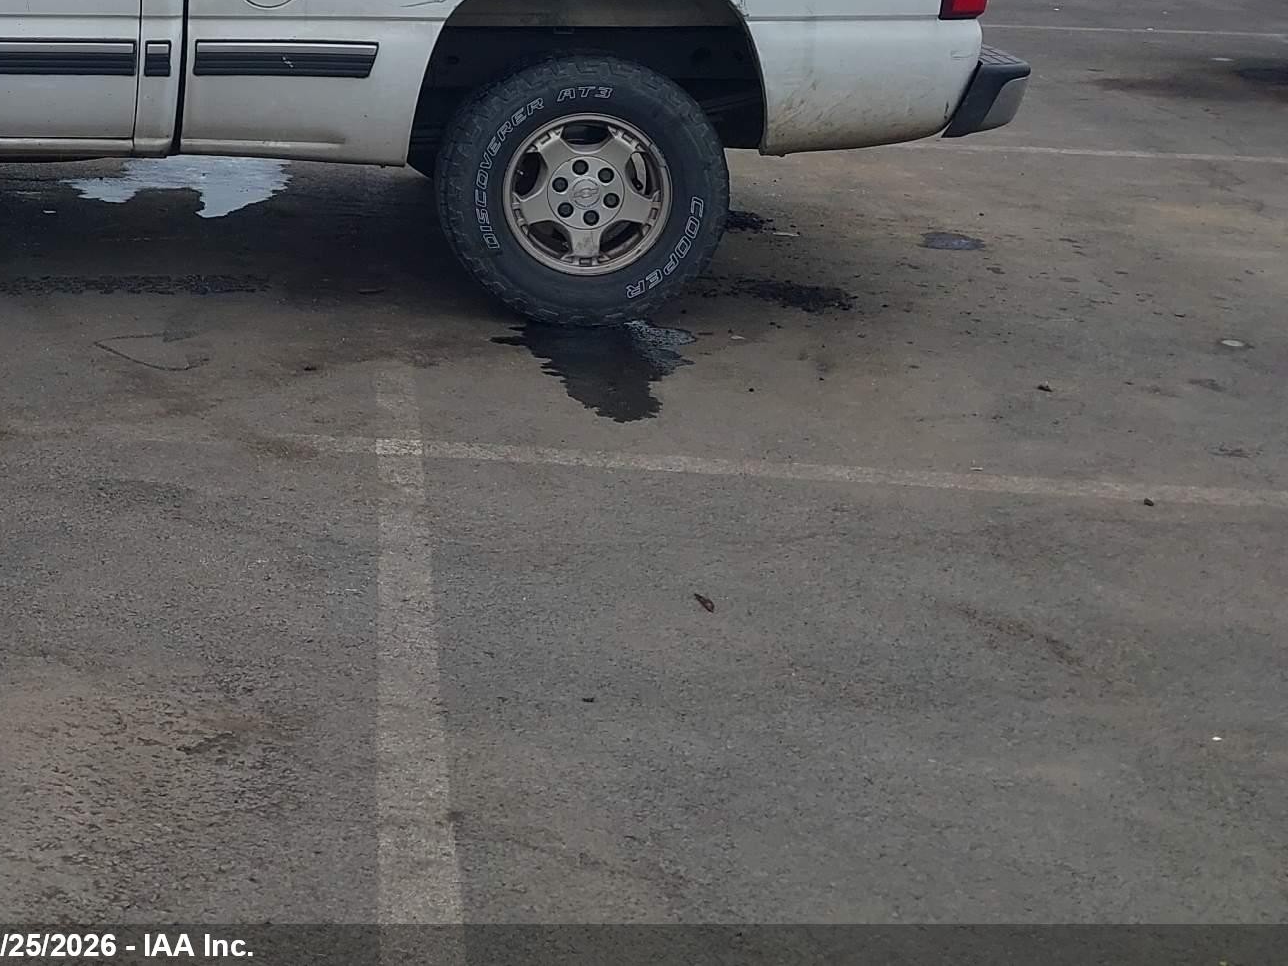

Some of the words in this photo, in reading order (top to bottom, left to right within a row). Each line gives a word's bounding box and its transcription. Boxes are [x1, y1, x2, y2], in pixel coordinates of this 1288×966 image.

[473, 97, 545, 250] DISCOVERER
[557, 86, 614, 102] AT3
[625, 195, 705, 299] COOPER
